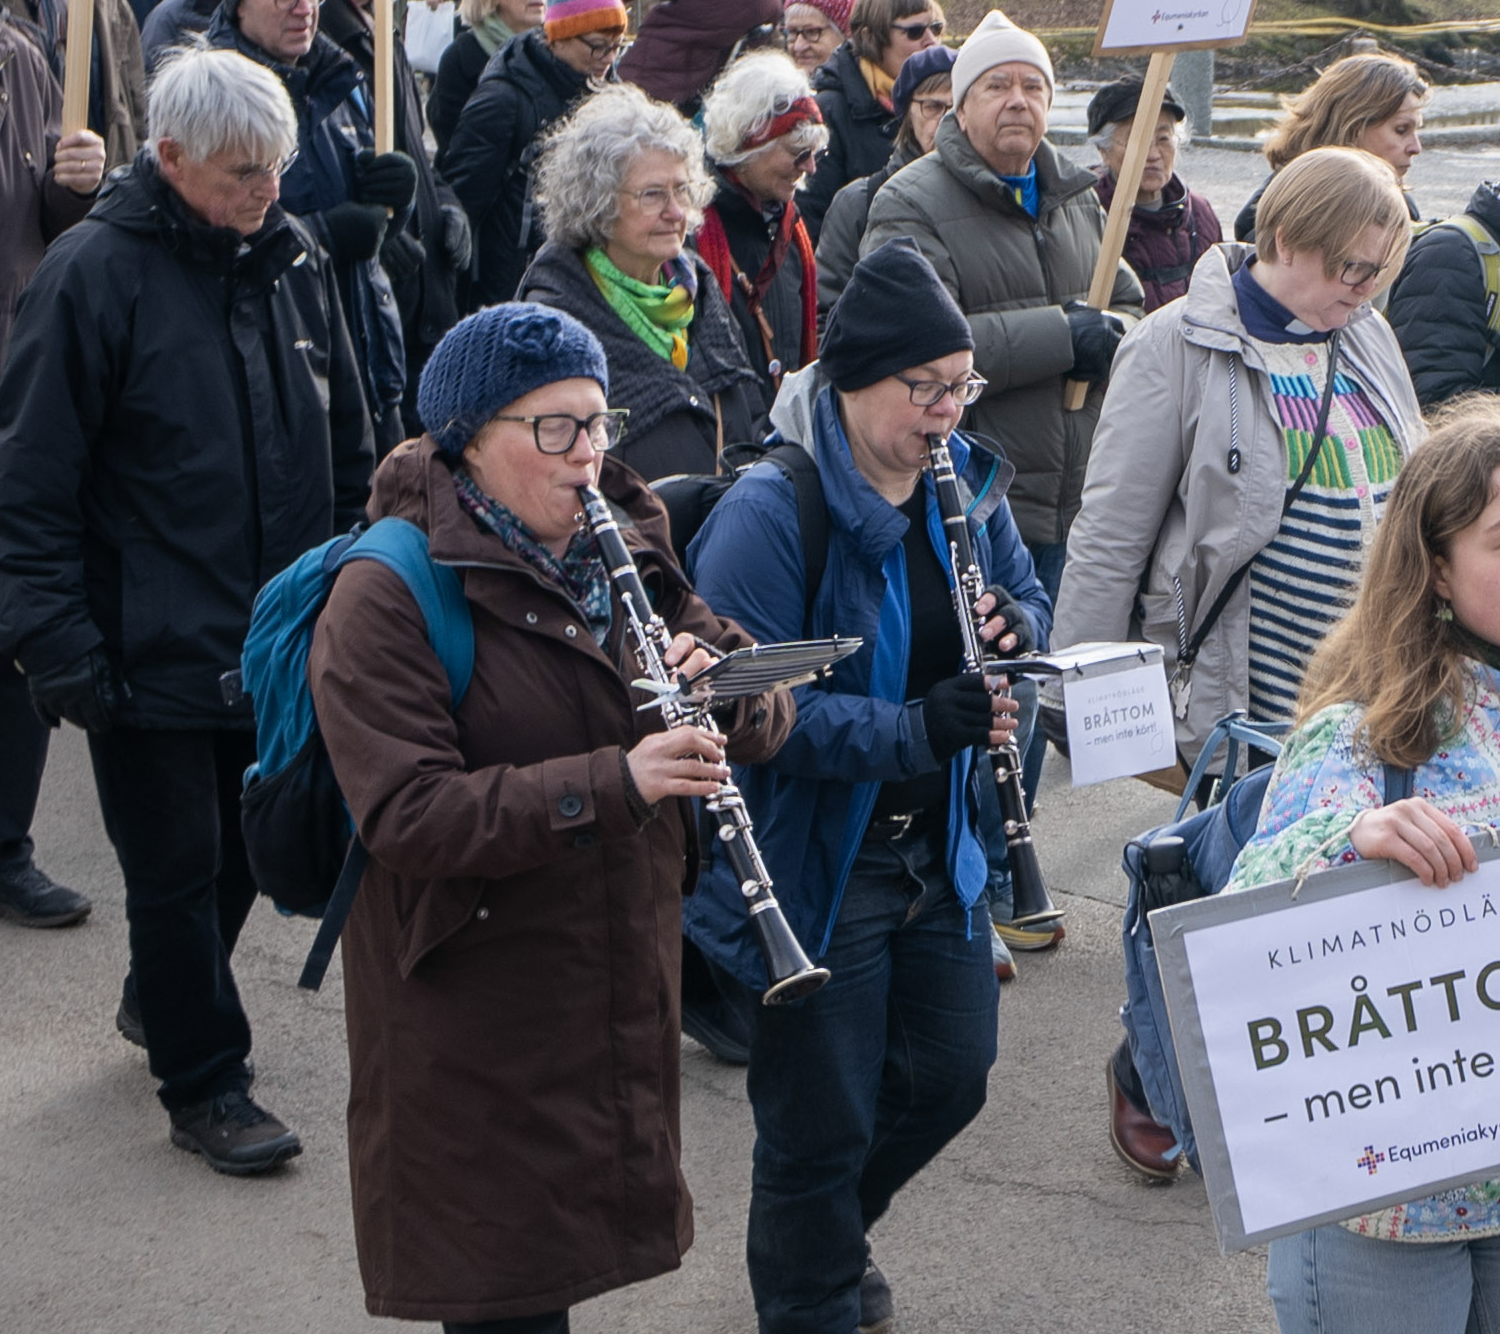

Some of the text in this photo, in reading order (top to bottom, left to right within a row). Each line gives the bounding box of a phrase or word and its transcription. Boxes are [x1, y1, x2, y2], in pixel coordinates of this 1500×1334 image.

[1083, 702, 1155, 731] BRÅTTOM
[1093, 735, 1114, 746] men
[1115, 729, 1133, 740] inte
[1135, 722, 1157, 737] kört!
[1304, 1075, 1401, 1122] men
[1411, 1048, 1495, 1094] inte
